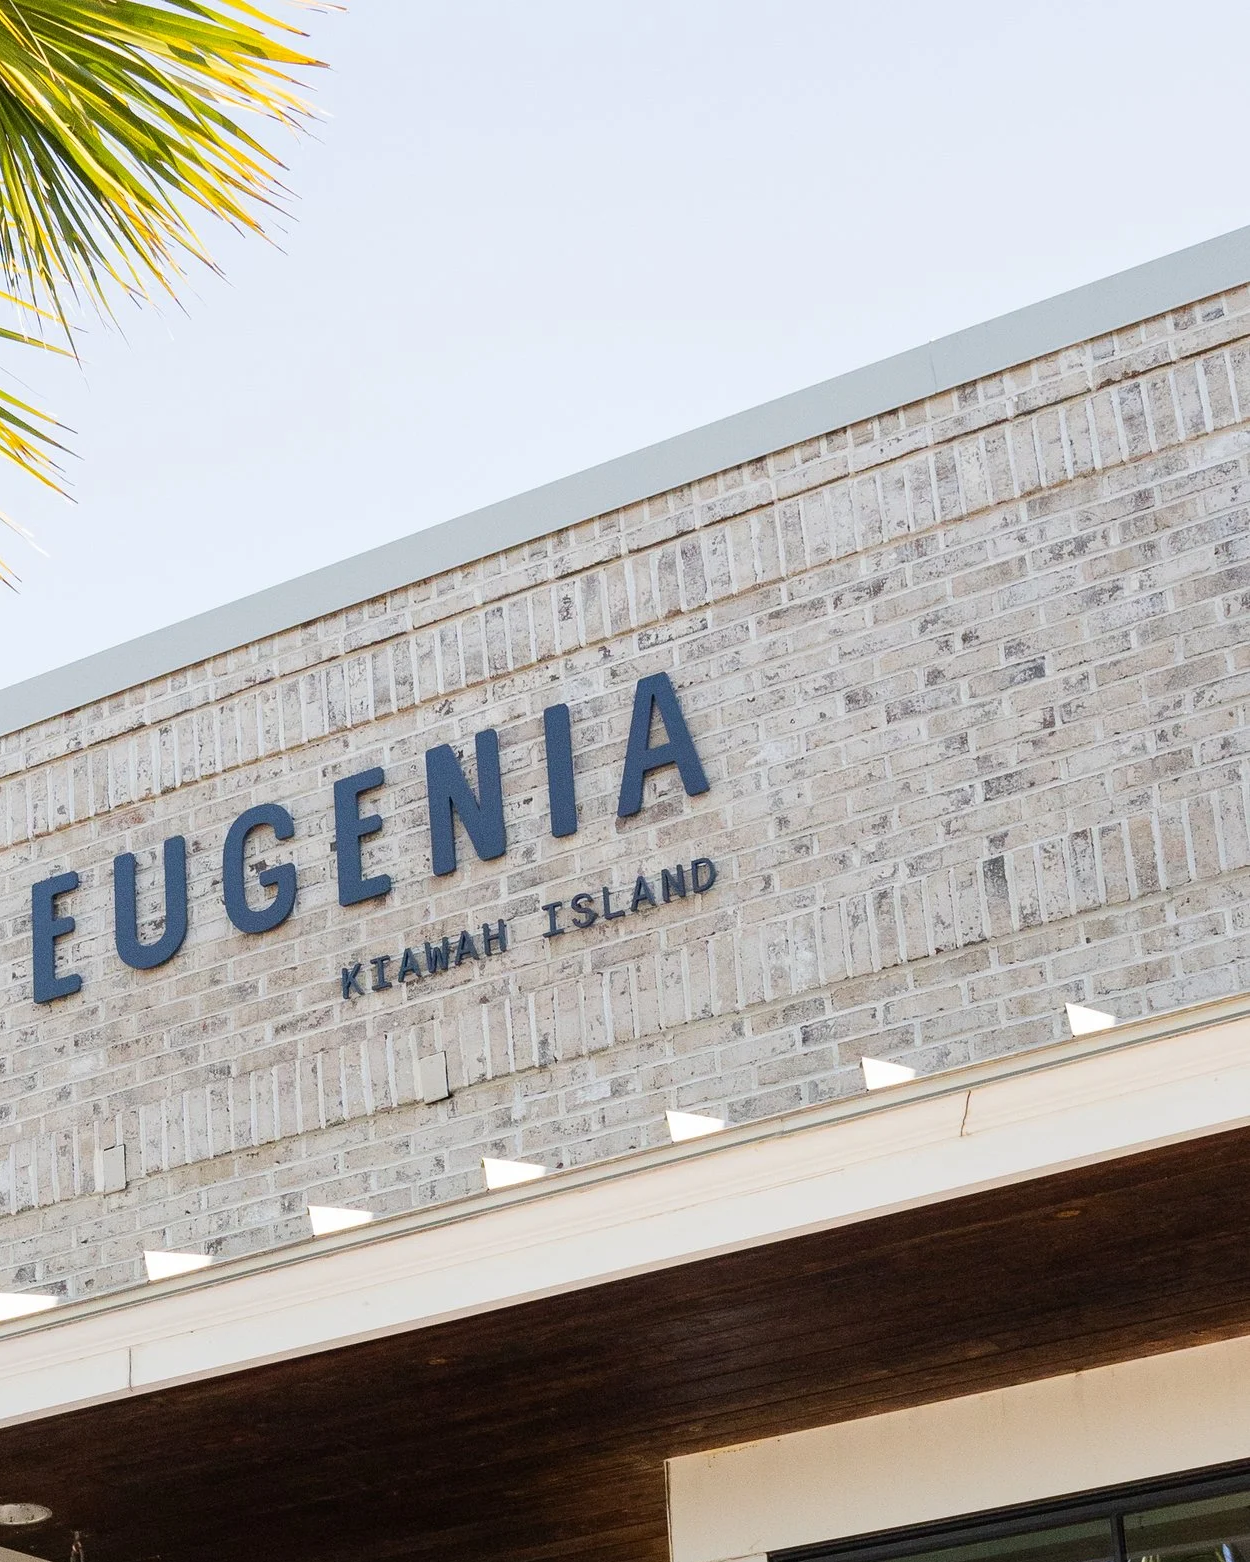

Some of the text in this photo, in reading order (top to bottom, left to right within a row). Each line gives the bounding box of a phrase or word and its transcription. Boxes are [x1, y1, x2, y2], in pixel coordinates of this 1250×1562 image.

[32, 671, 710, 1003] EUGENIA
[341, 857, 717, 1000] KIAWAH ISLAND
